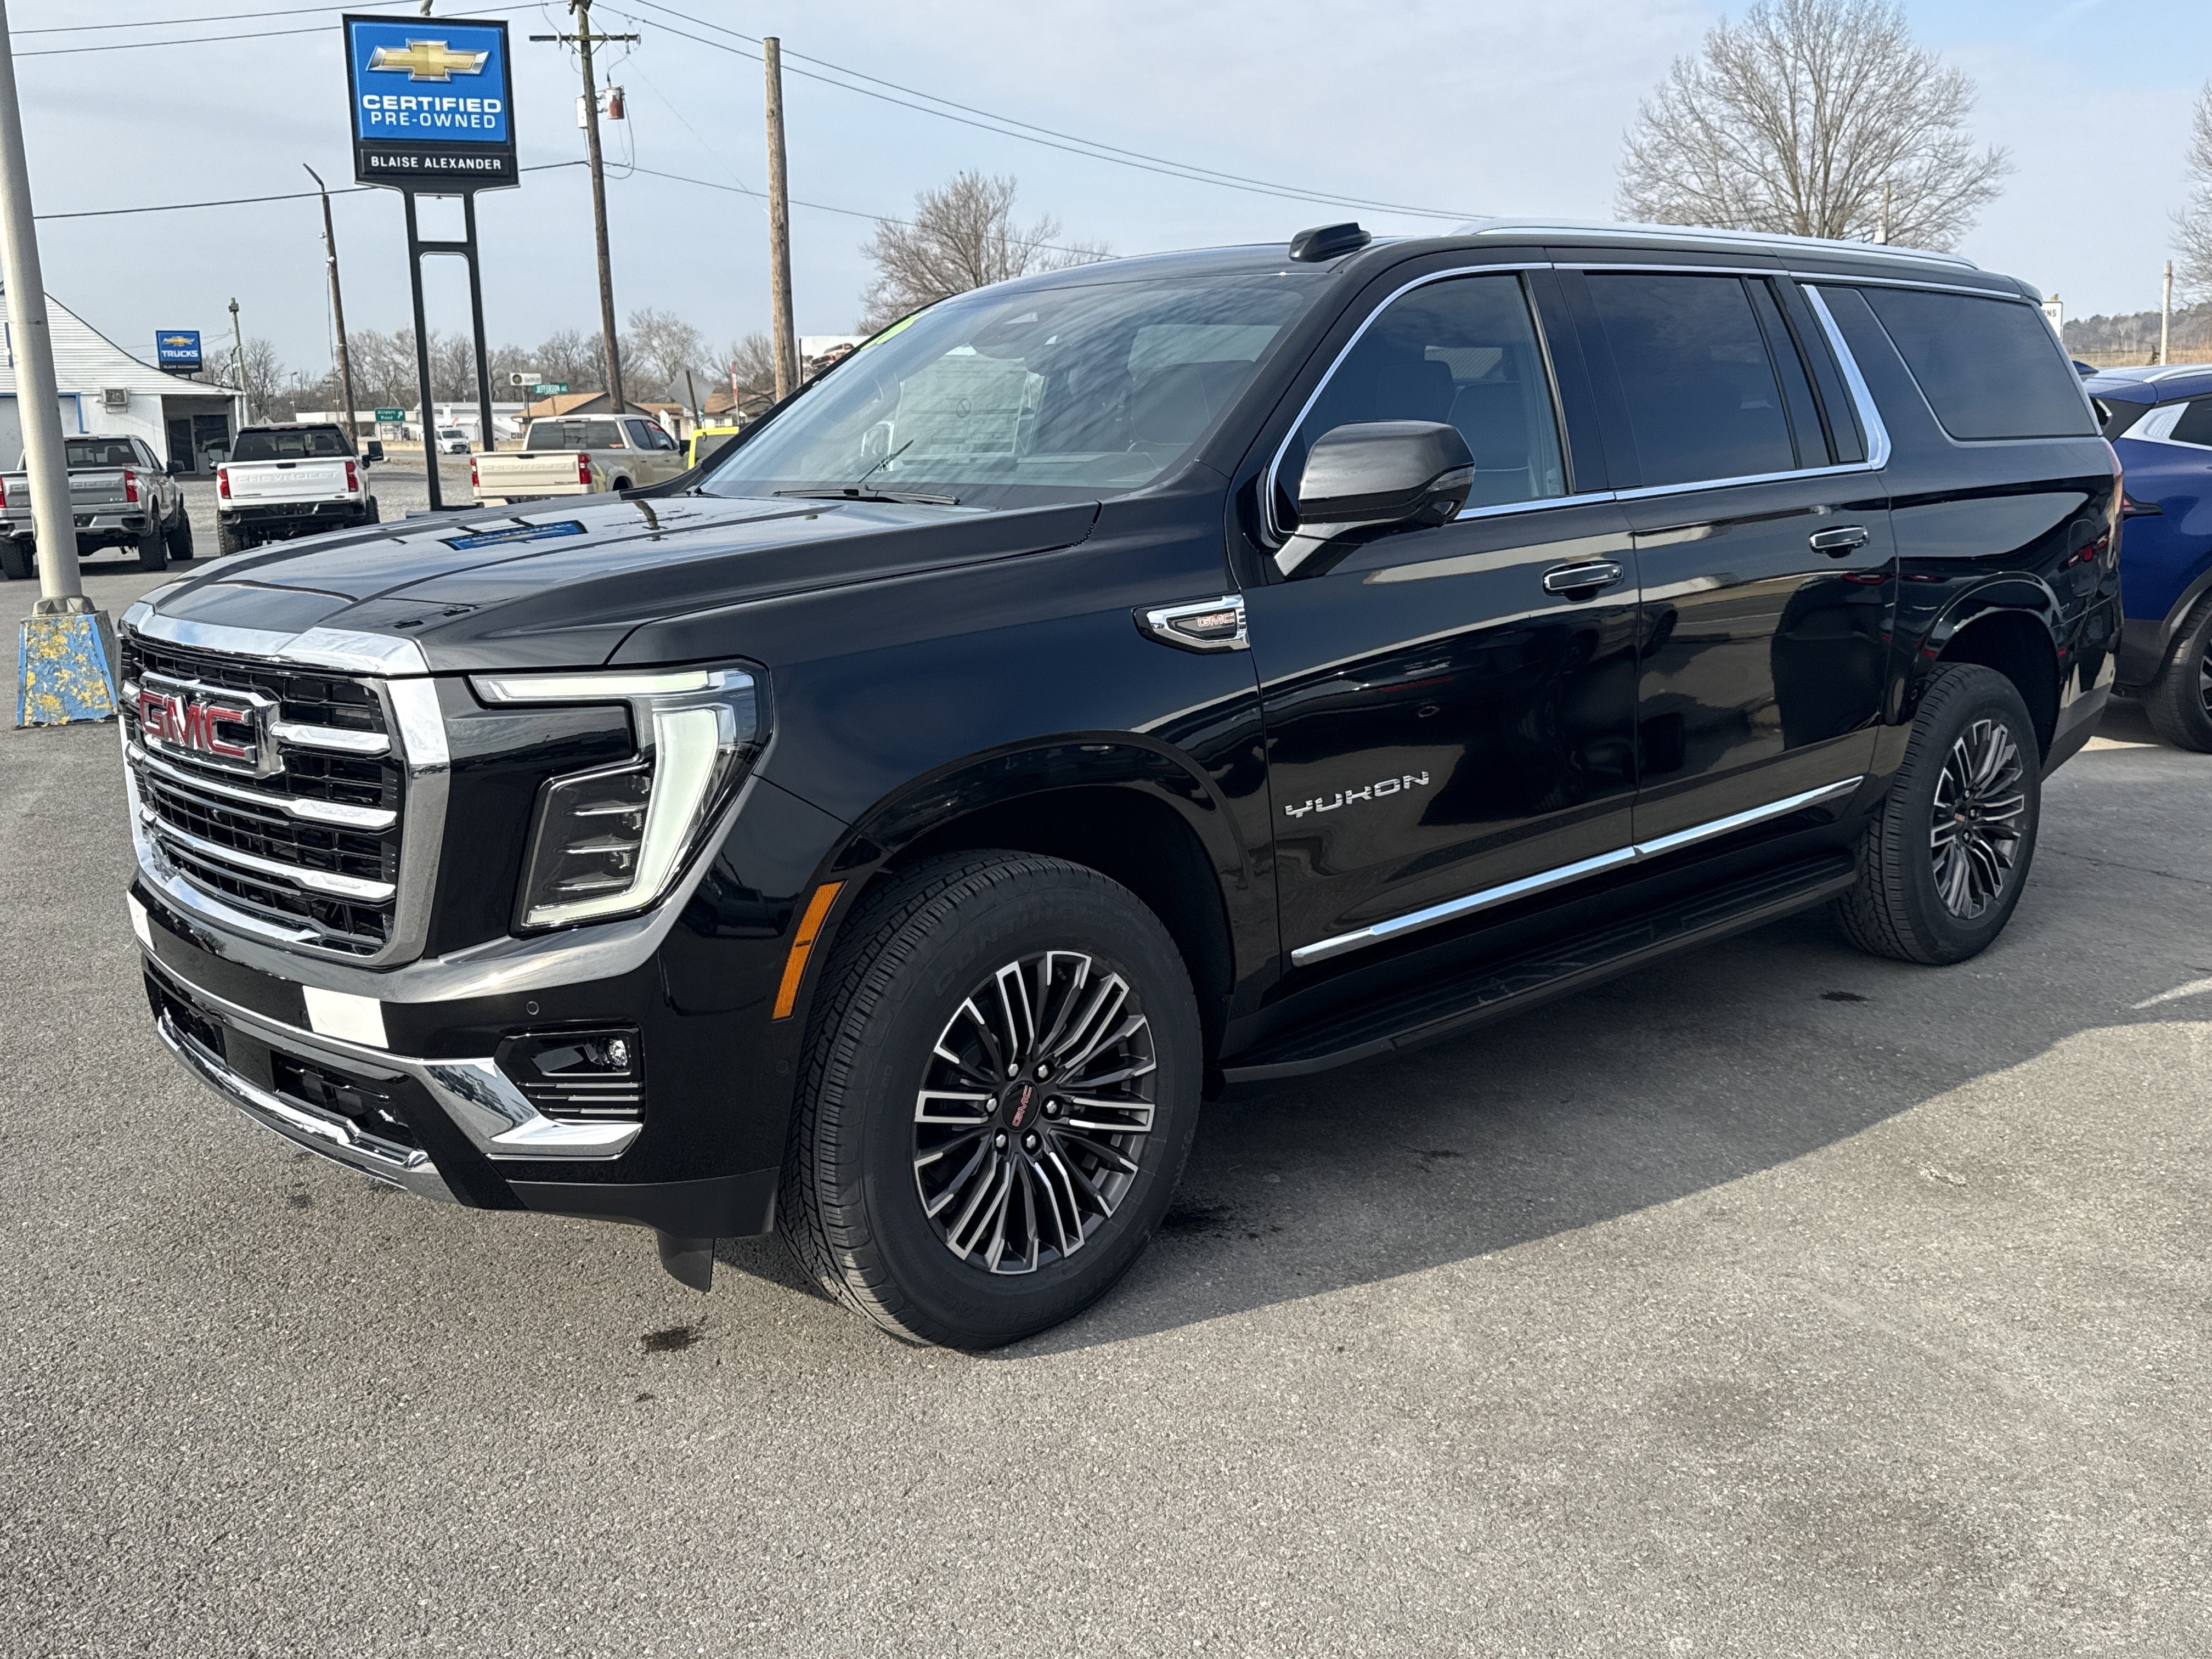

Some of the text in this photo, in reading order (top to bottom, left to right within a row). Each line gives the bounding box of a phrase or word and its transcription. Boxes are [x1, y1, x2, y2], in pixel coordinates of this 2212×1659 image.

[363, 94, 501, 113] CERTIFIED
[370, 111, 496, 128] PRE-OWNED
[371, 156, 501, 170] BLAISE ALEXANDER
[1197, 612, 1235, 628] GMC
[139, 688, 256, 764] GMC
[1284, 771, 1429, 818] YUKON
[1012, 1084, 1032, 1127] GMC
